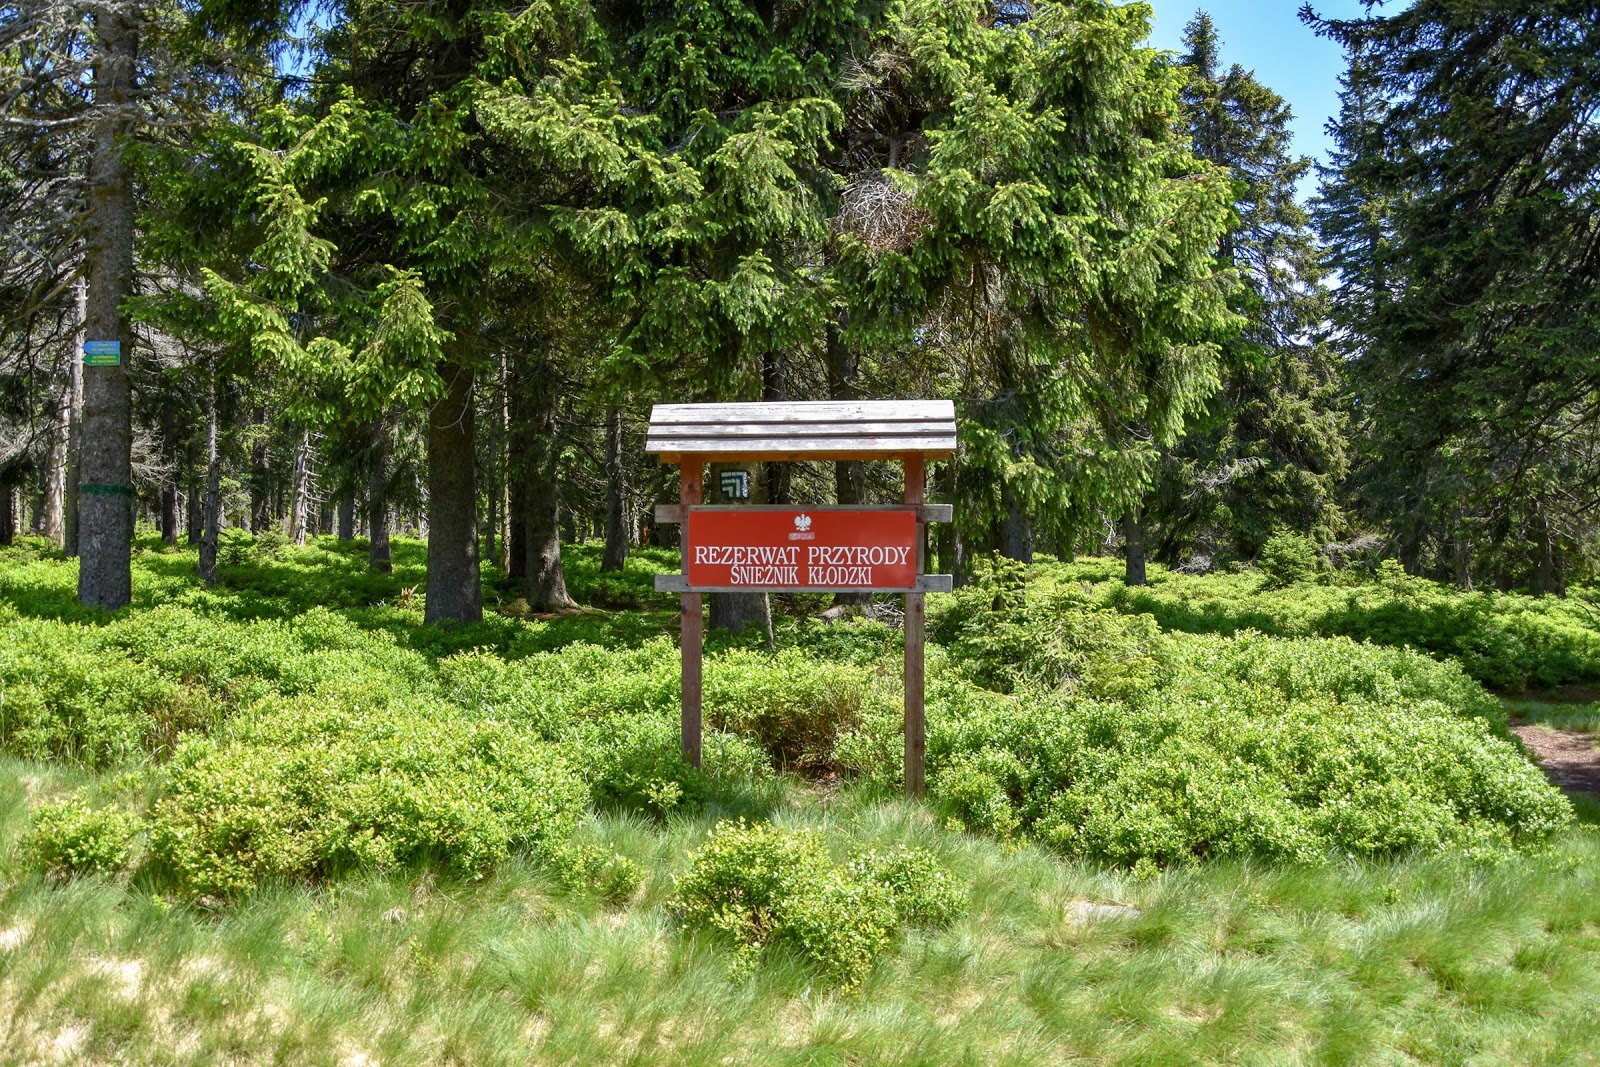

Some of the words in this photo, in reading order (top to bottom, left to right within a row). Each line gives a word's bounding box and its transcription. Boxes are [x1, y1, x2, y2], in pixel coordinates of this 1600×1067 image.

[694, 546, 800, 564] REZERWAT
[807, 546, 911, 564] PRZYRODY
[730, 564, 799, 585] ŚNIEŻNIK
[808, 566, 872, 585] KŁODZKI
